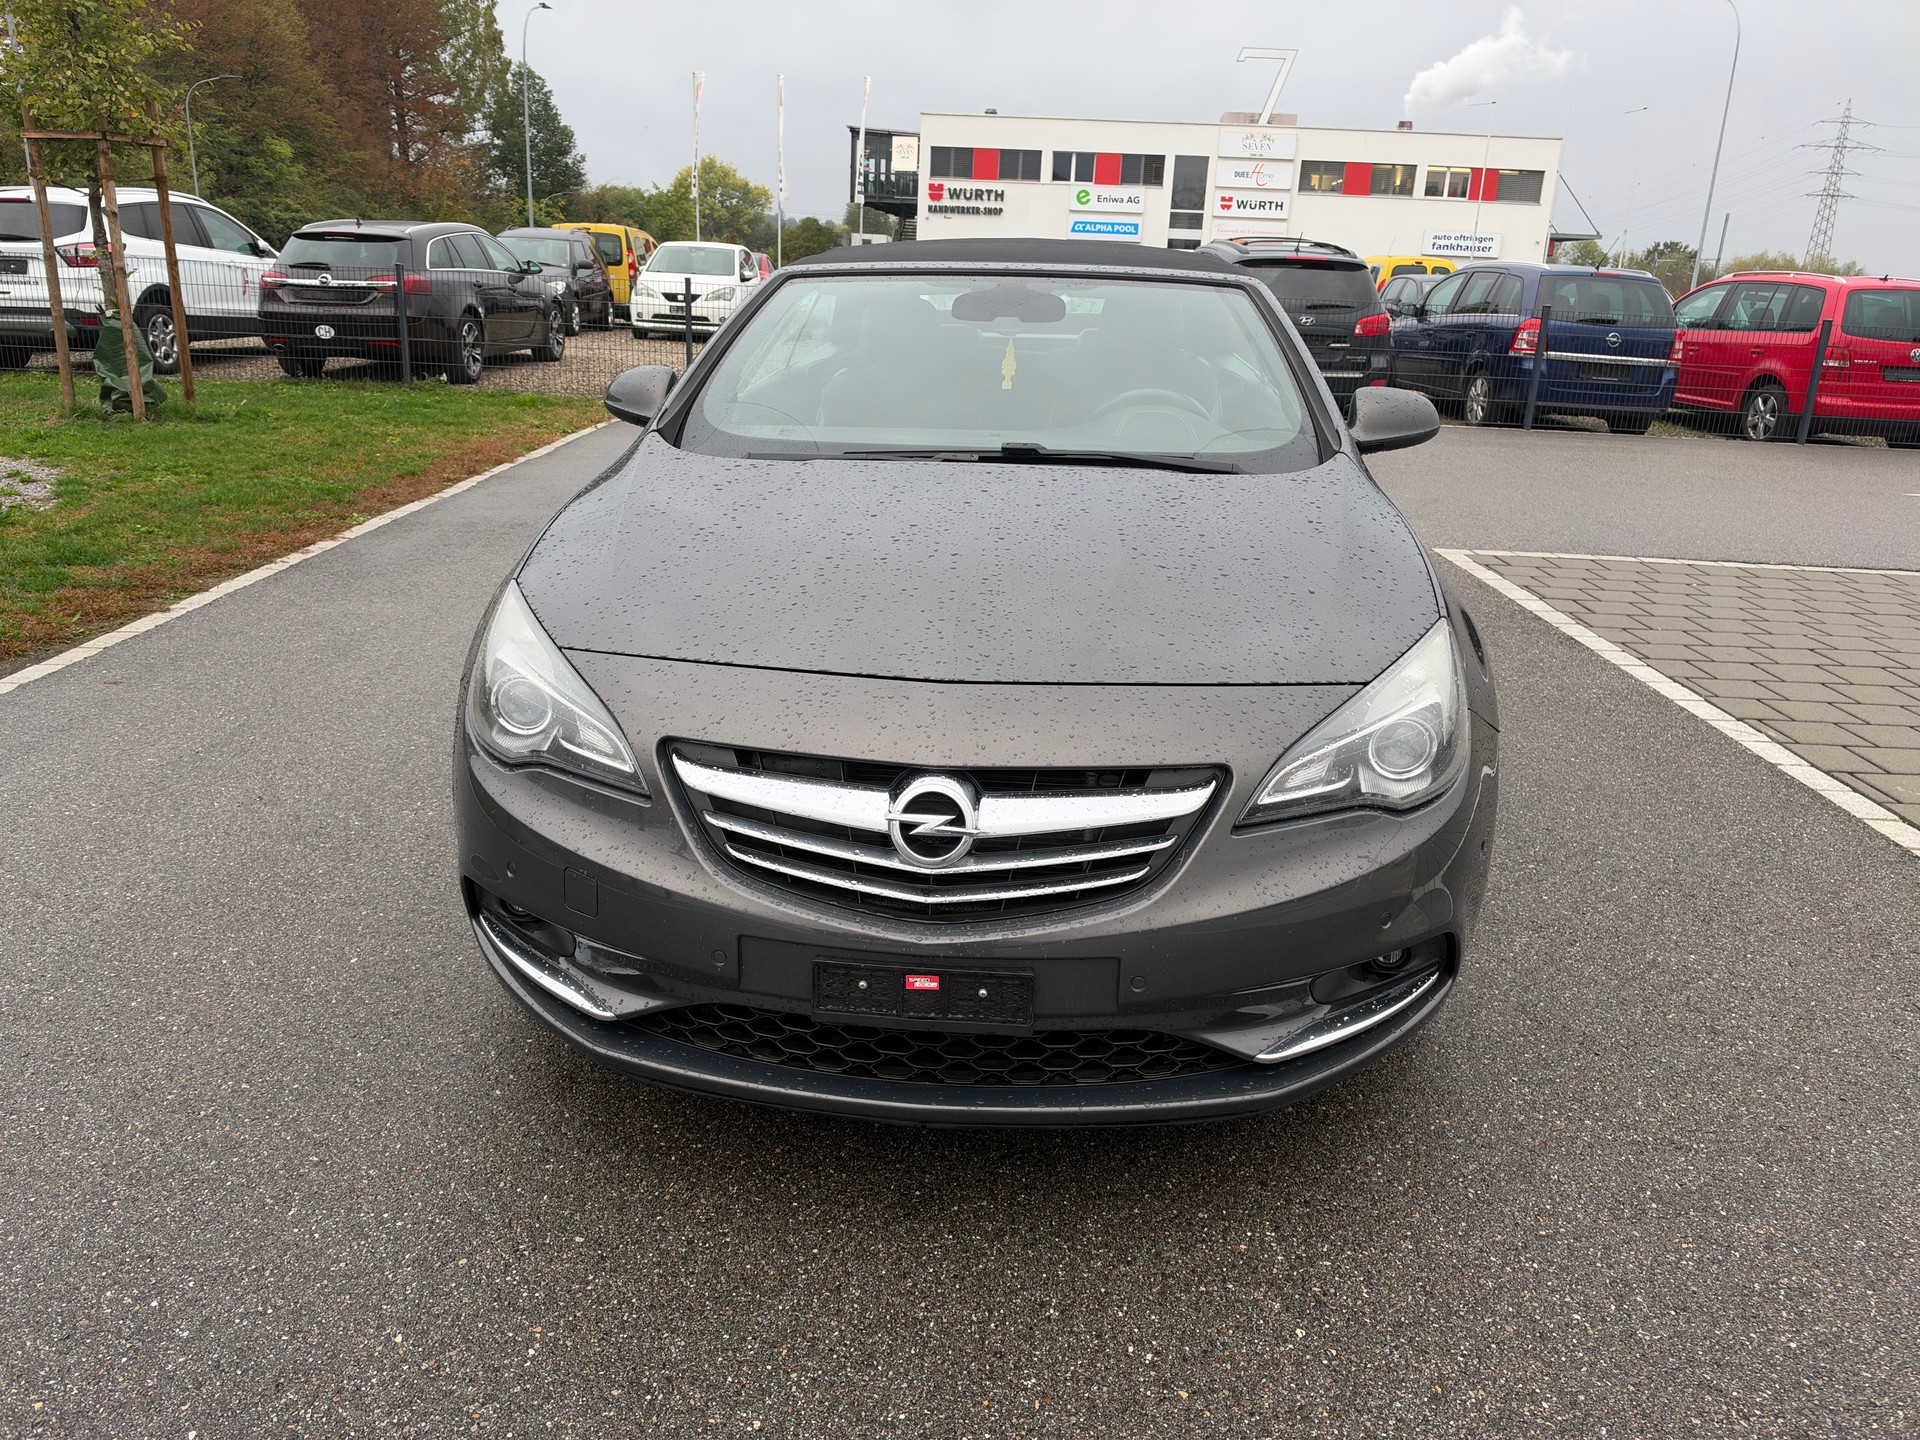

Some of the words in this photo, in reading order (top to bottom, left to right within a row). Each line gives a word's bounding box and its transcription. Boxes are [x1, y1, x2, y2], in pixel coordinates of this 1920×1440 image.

[1242, 143, 1272, 151] SEVEN
[948, 187, 1005, 202] WÜRTH
[1097, 194, 1124, 204] Eniwa
[1126, 196, 1140, 205] AG
[927, 204, 1004, 216] HANDWERKER-SHOP
[1236, 199, 1284, 211] WÜRTH
[1084, 224, 1113, 232] ALPHA
[1114, 225, 1136, 233] POOL
[1431, 242, 1493, 253] fankhauser
[318, 327, 331, 338] CH
